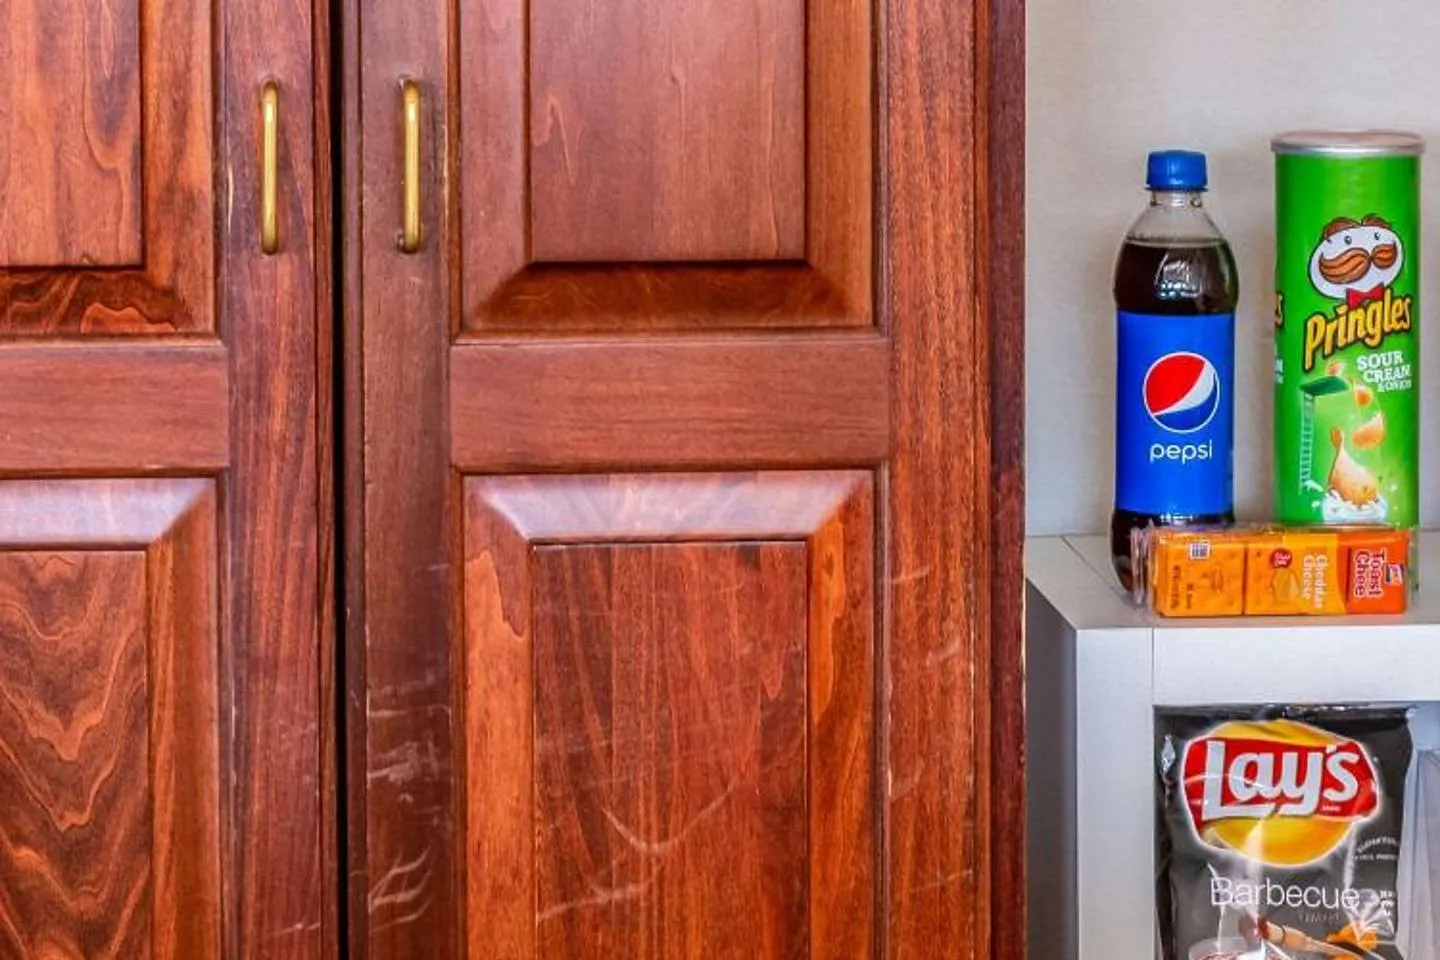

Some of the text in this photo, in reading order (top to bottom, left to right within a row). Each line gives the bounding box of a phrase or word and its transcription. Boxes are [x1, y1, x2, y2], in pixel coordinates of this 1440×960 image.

[1304, 288, 1412, 372] Pringles
[1357, 351, 1404, 370] SOUR
[1363, 364, 1412, 383] CREAM
[1149, 439, 1213, 464] pepsi
[1355, 550, 1369, 597] Chee
[1369, 550, 1386, 597] Toast
[1202, 740, 1359, 820] Lay's
[1210, 876, 1360, 910] Barbecue
